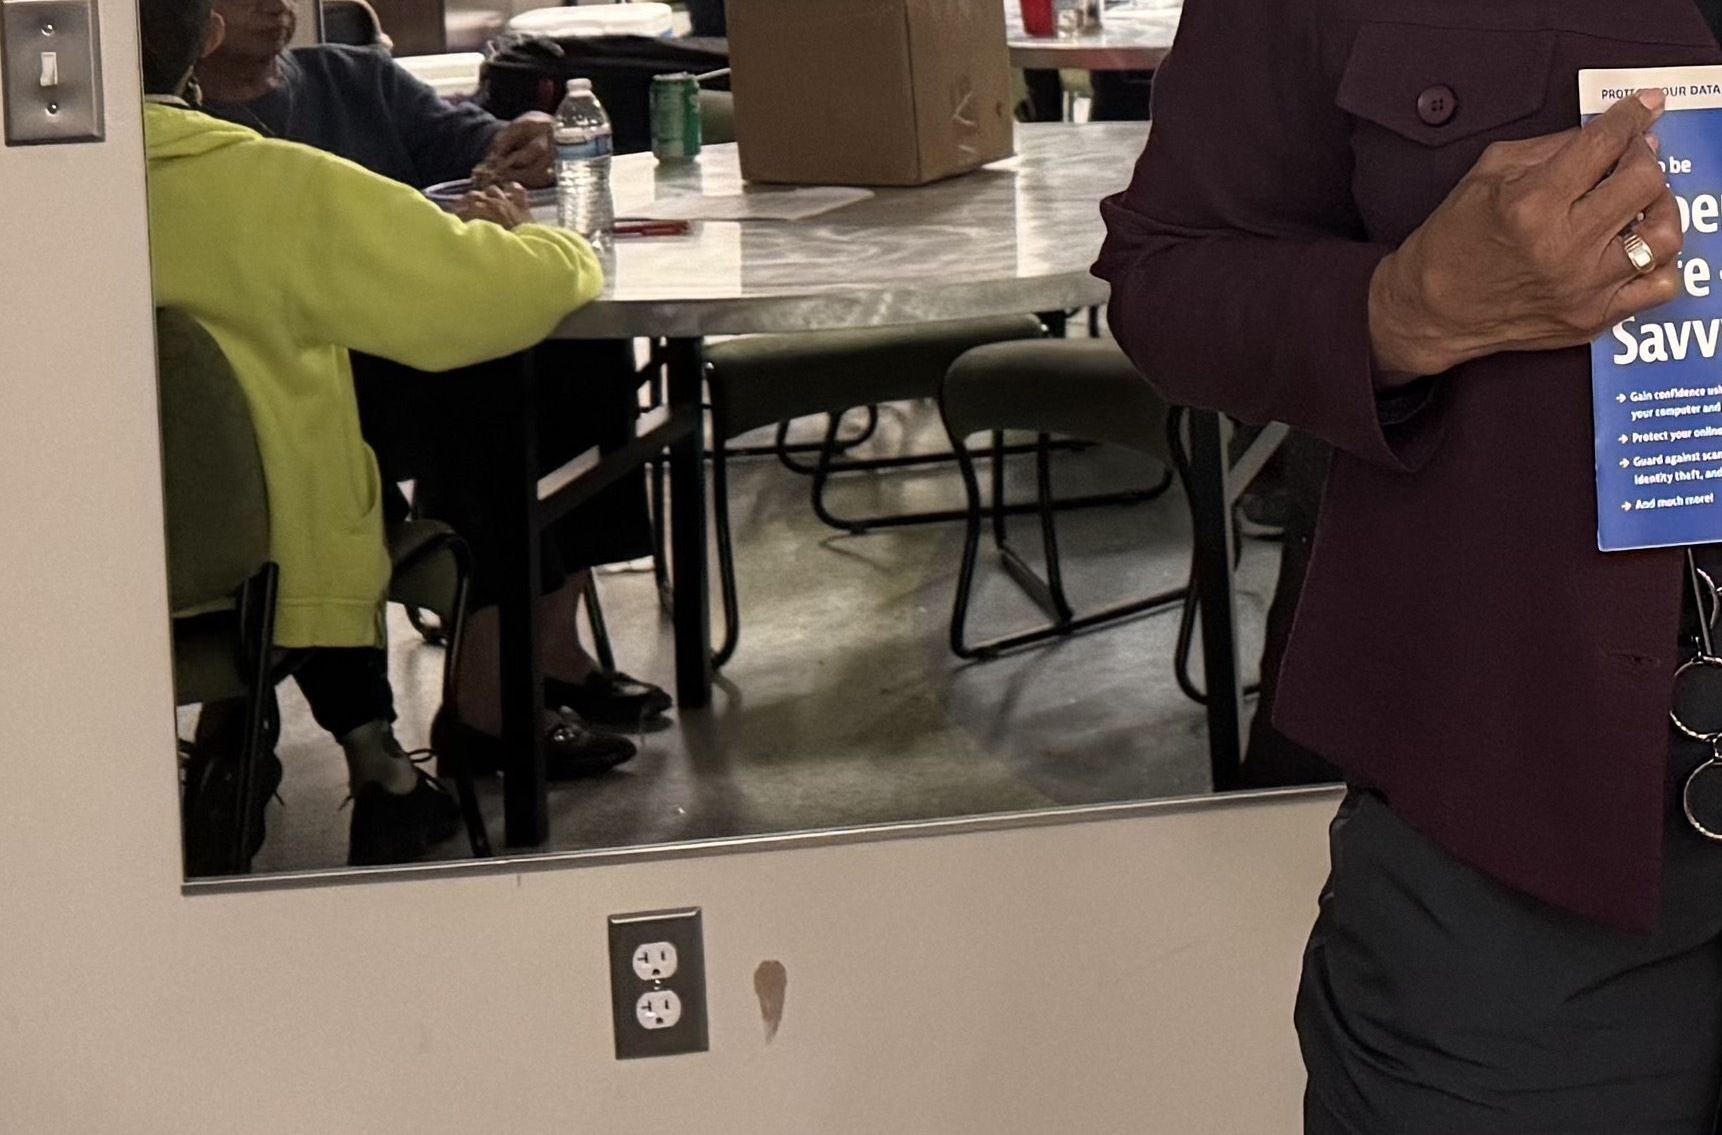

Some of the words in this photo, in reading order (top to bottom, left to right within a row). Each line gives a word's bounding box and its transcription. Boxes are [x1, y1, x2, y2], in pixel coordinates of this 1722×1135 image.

[1662, 85, 1687, 97] OUR
[1690, 84, 1721, 95] DATA
[1669, 156, 1692, 174] be
[1630, 390, 1653, 402] Gain
[1654, 386, 1706, 401] confidence
[1631, 408, 1654, 422] your
[1655, 404, 1701, 418] computer
[1702, 401, 1722, 413] and
[1632, 431, 1669, 444] Protect
[1669, 429, 1693, 443] your
[1632, 454, 1664, 467] Guard
[1664, 451, 1701, 466] against
[1674, 468, 1704, 482] theft,
[1635, 497, 1656, 510] And
[1657, 495, 1684, 508] much
